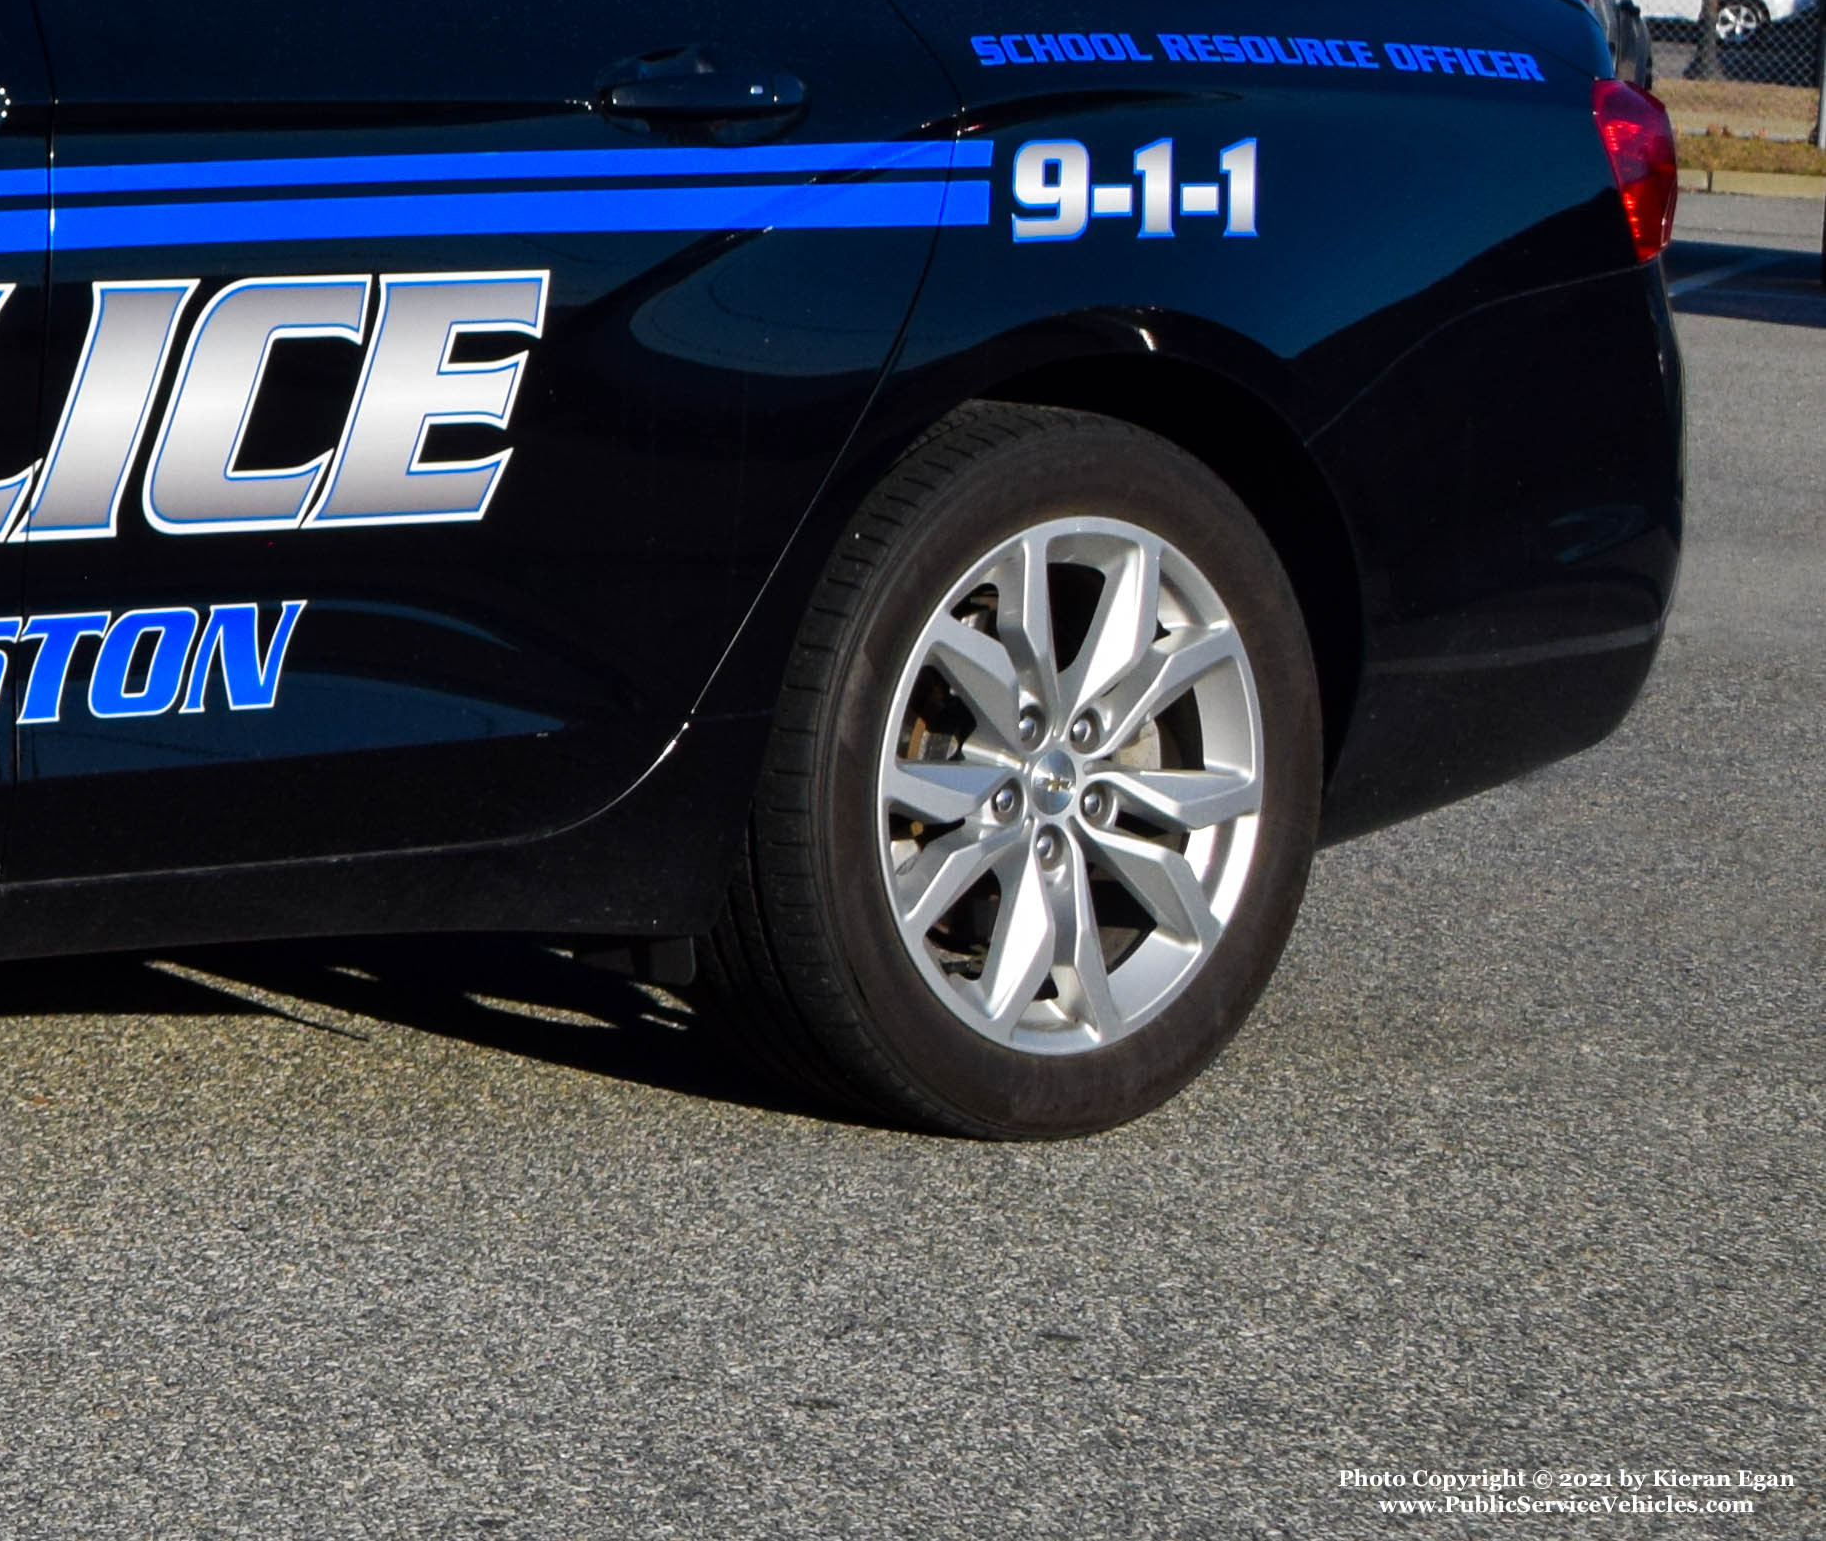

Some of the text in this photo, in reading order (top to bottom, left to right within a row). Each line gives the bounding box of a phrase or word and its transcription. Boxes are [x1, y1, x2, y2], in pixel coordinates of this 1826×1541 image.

[970, 33, 1546, 82] SCHOOL RESOURCE OFFICER
[1012, 137, 1258, 243] 9-1-1
